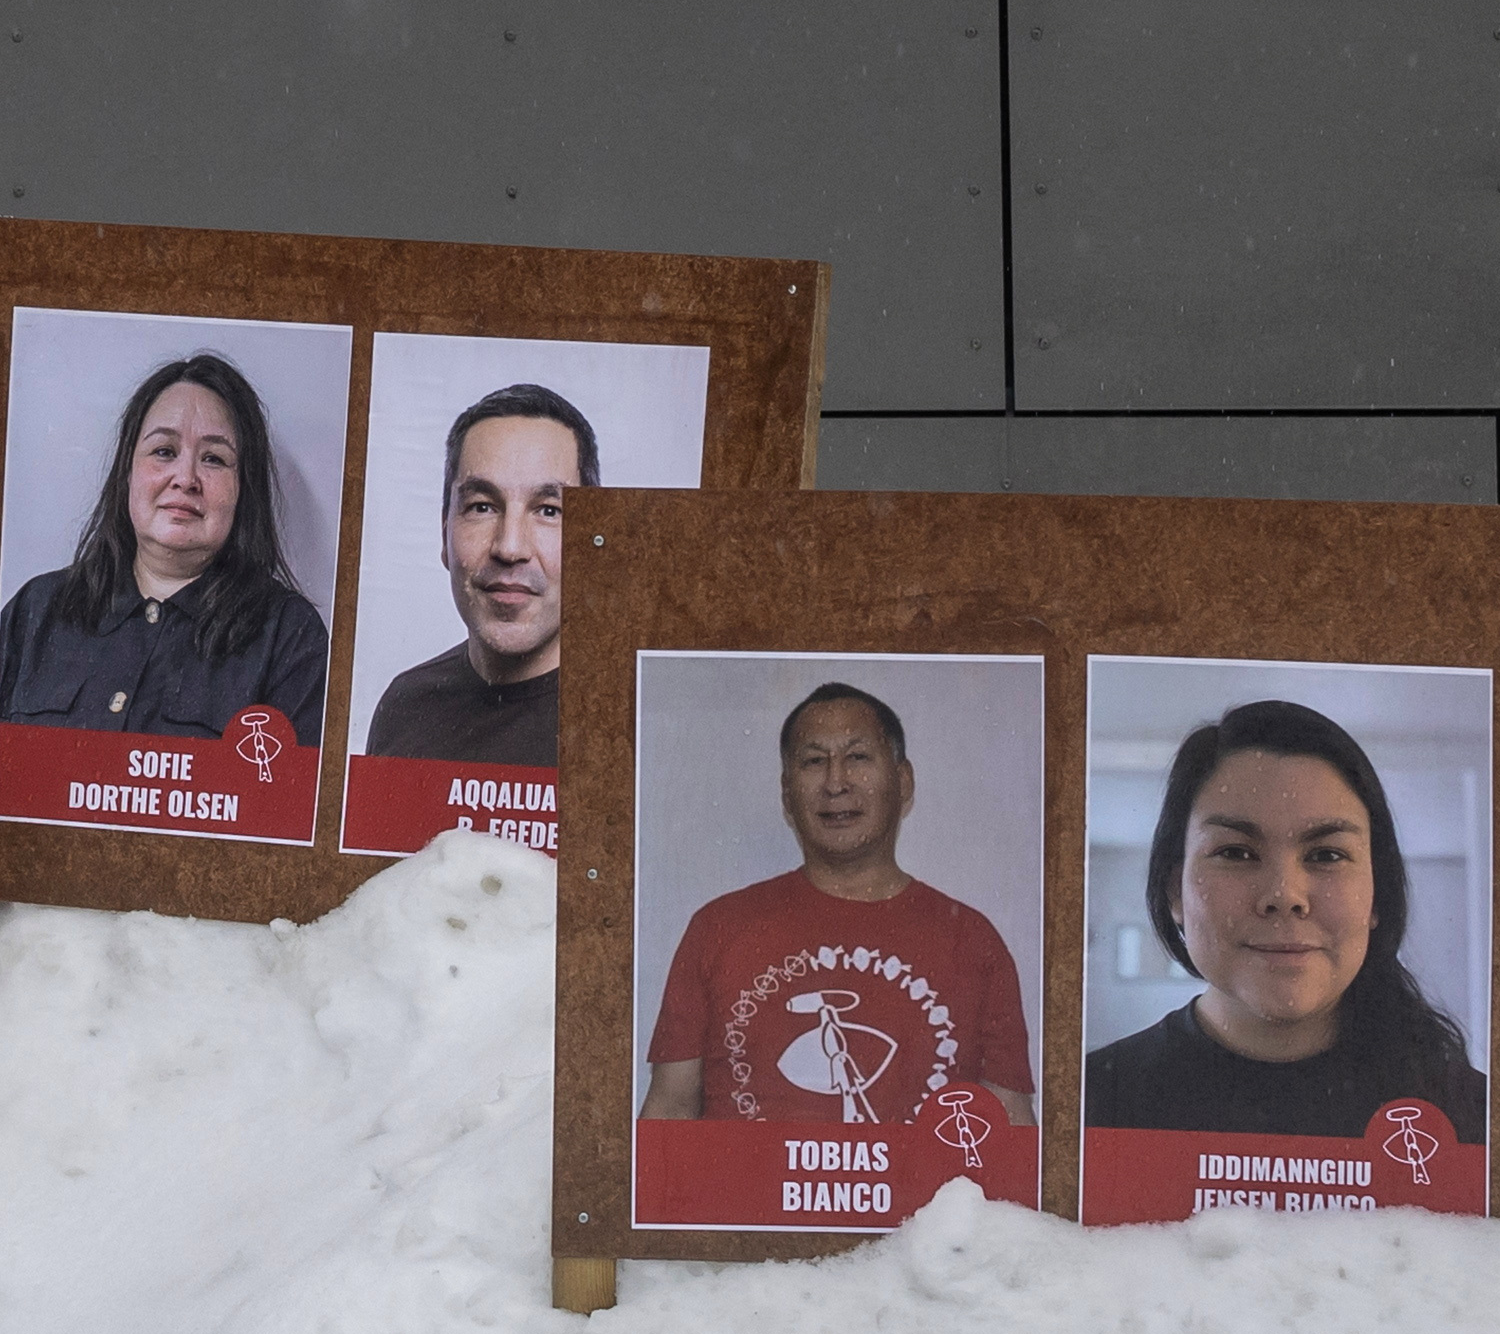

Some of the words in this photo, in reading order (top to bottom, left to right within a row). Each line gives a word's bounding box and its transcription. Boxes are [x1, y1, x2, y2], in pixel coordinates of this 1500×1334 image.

[128, 749, 194, 781] SOFIE
[68, 781, 162, 815] DORTHE
[167, 789, 239, 822] OLSEN
[447, 778, 556, 812] AQQALUA
[784, 1140, 889, 1173] TOBIAS
[1198, 1154, 1372, 1187] IDDIMANNGIIU
[782, 1181, 891, 1213] BIANCO
[1192, 1188, 1276, 1213] JENSEN
[1284, 1191, 1376, 1213] BIANCO
